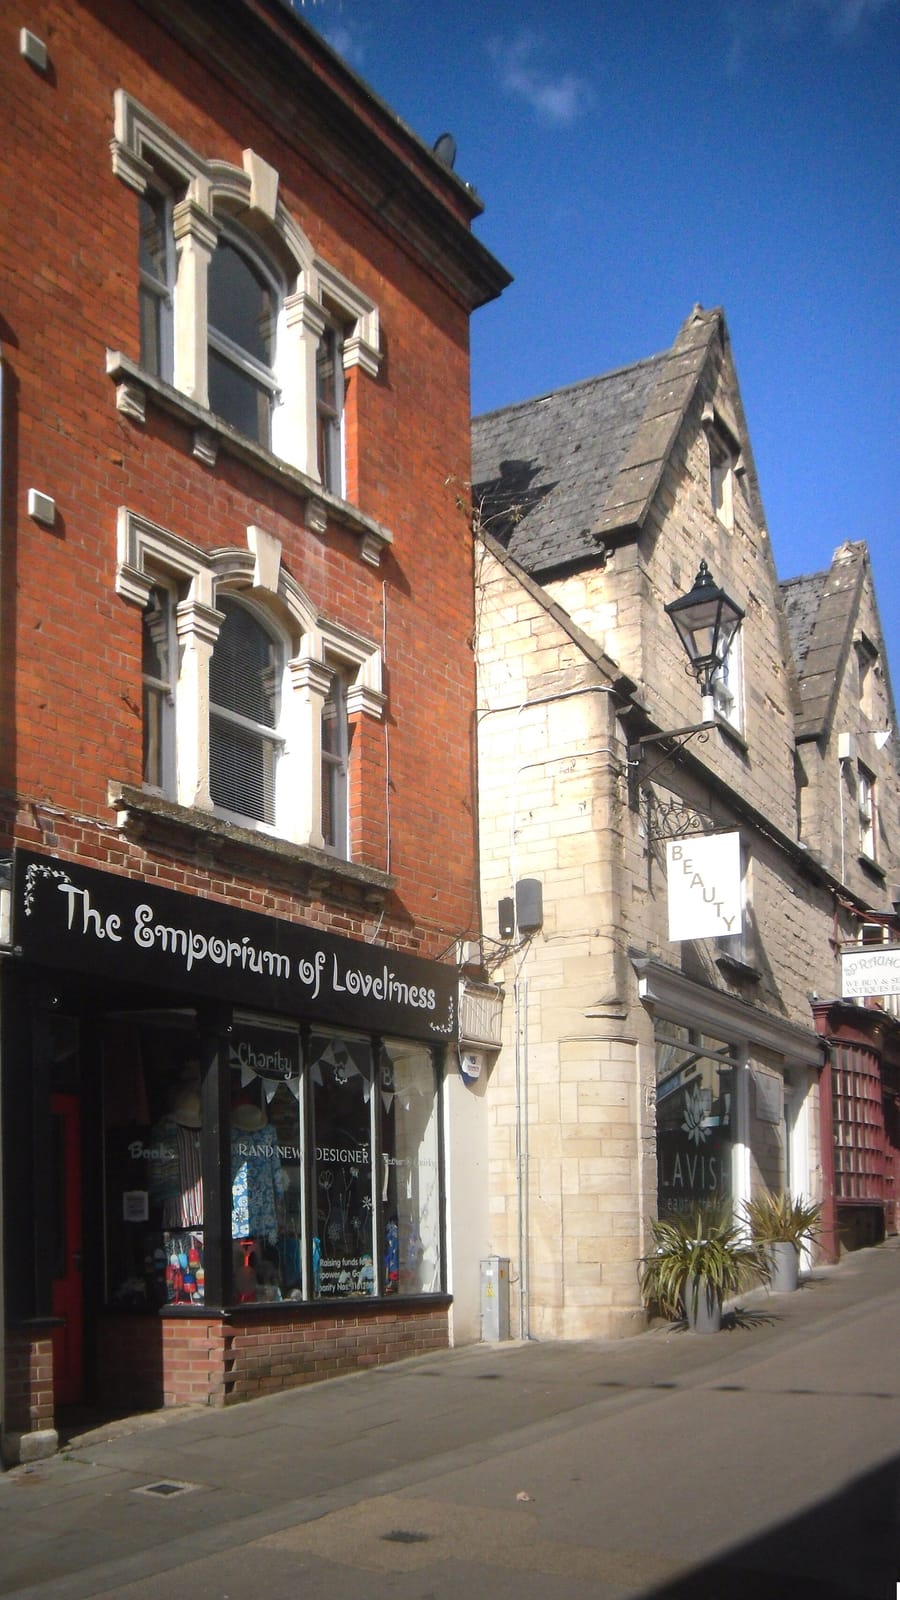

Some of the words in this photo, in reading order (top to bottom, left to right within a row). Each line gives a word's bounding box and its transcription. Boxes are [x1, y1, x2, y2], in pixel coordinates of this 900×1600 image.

[671, 845, 736, 932] BEAUTY
[57, 883, 123, 943] The
[133, 904, 291, 979] Emporium
[298, 951, 326, 1000] of
[332, 952, 436, 1010] Loveliness
[238, 1042, 292, 1080] Charity
[237, 1143, 275, 1159] RAND
[315, 1148, 369, 1164] DESIGNER
[319, 1258, 341, 1269] Raising
[342, 1257, 358, 1266] funds
